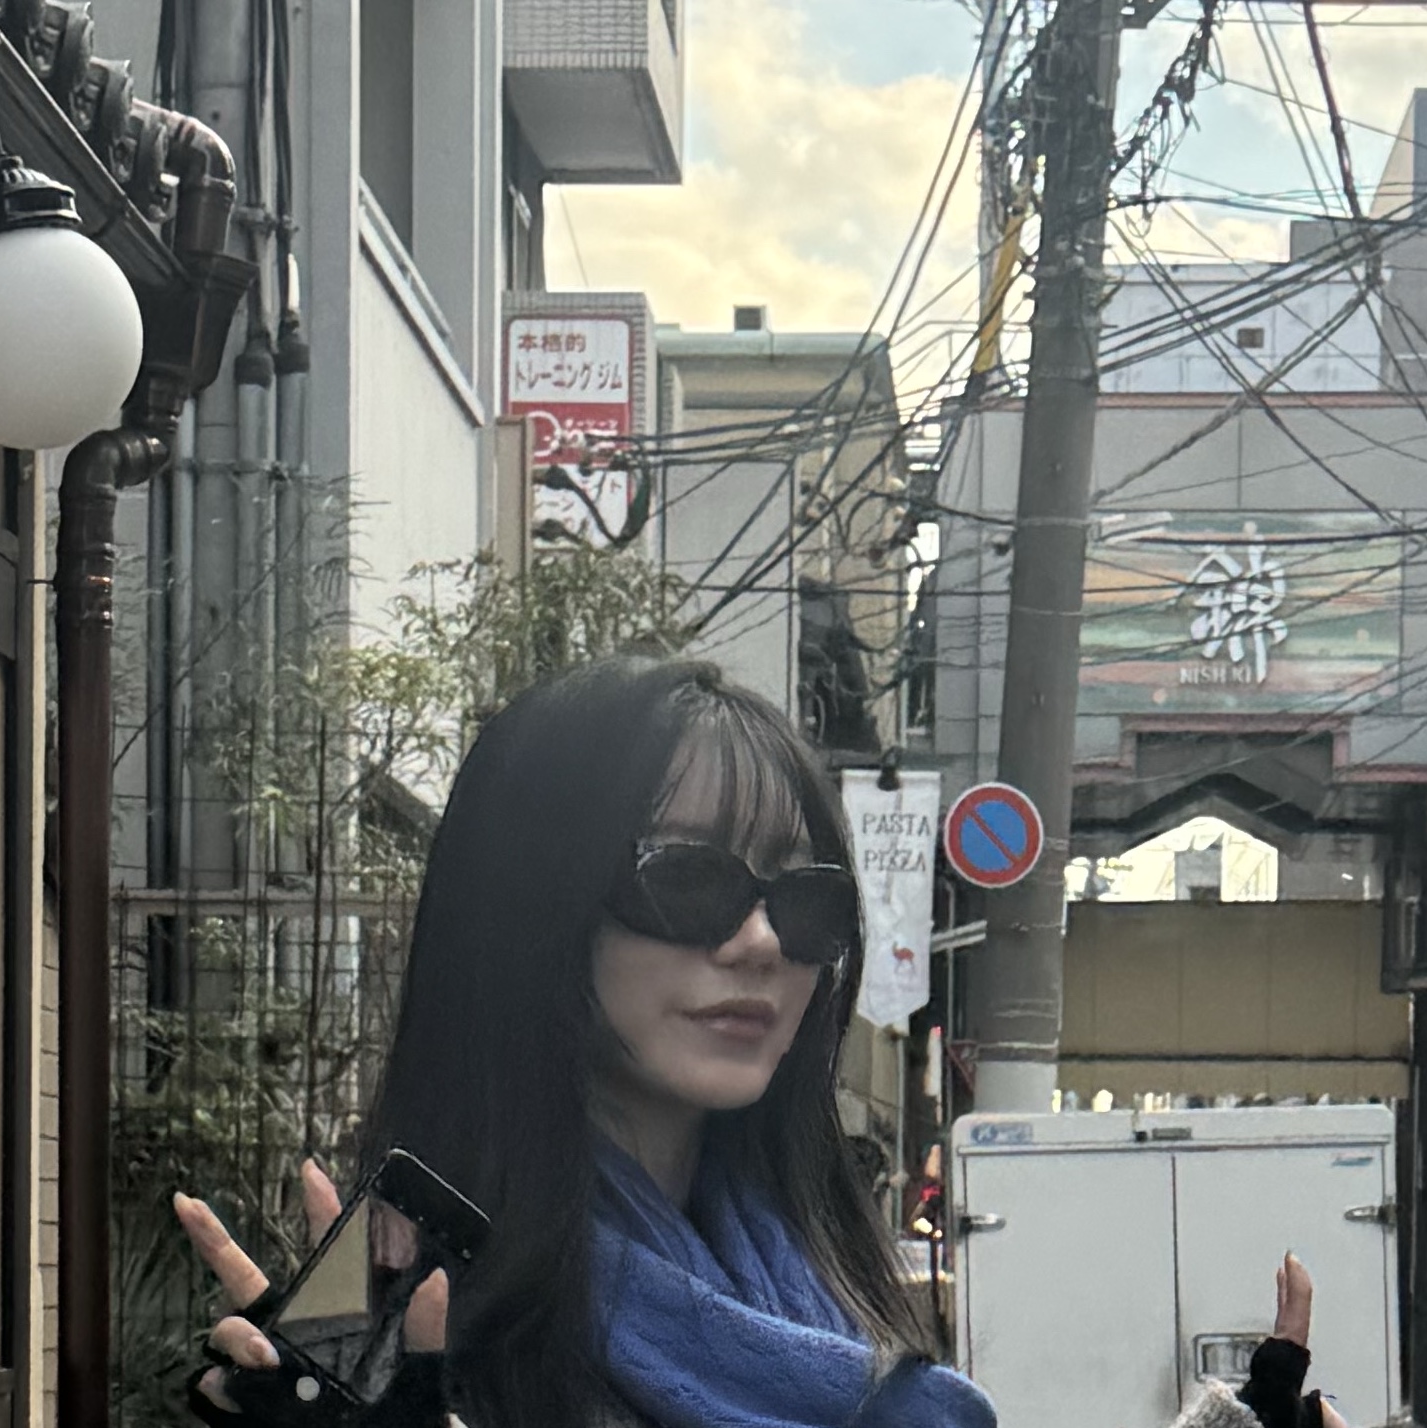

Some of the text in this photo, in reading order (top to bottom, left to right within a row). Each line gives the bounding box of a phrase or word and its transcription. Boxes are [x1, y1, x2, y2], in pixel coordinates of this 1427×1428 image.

[517, 331, 586, 353] 本格的
[1179, 664, 1252, 684] NISHKI
[861, 812, 932, 836] PASTA
